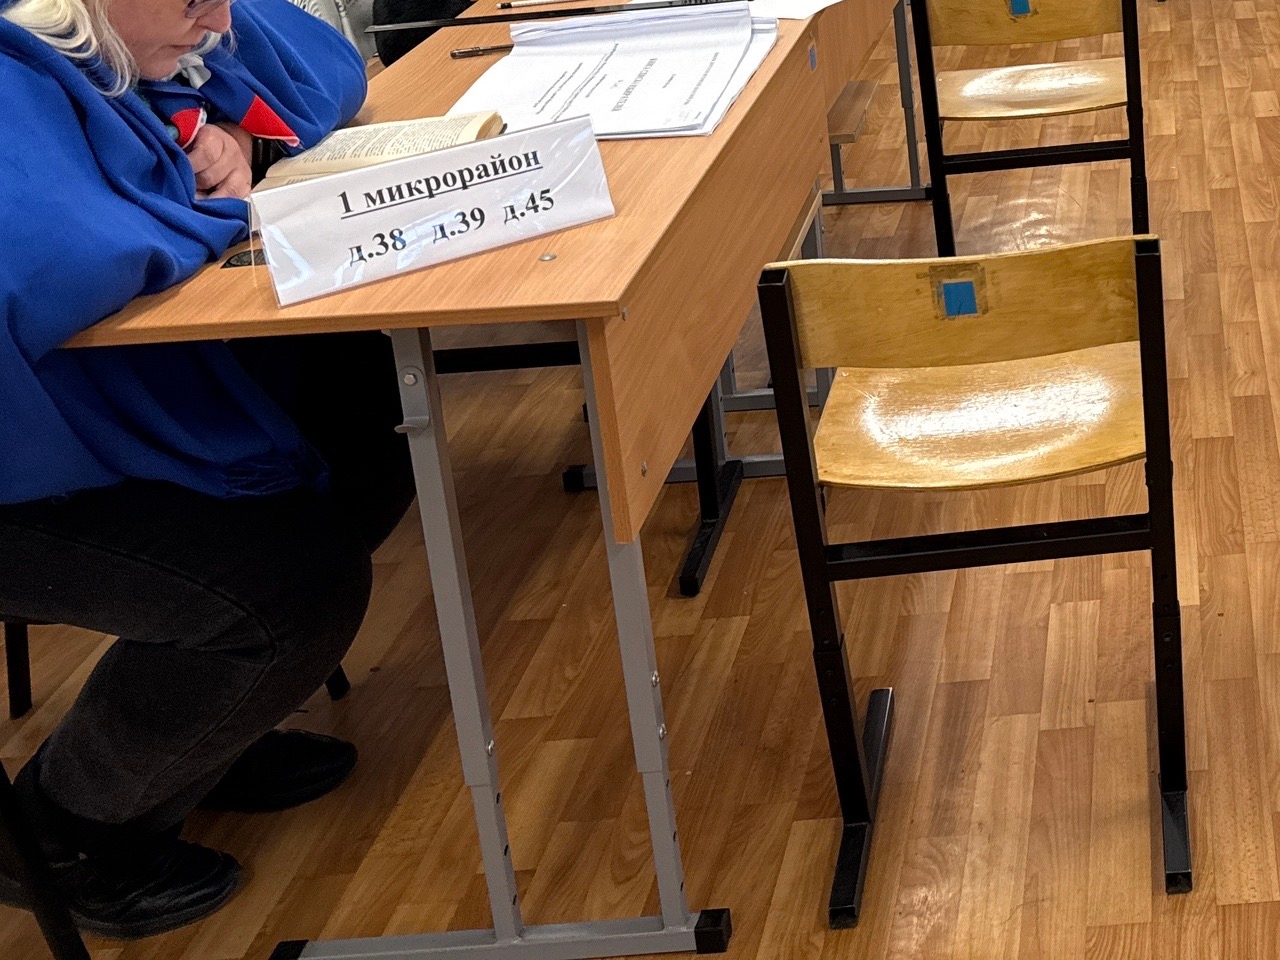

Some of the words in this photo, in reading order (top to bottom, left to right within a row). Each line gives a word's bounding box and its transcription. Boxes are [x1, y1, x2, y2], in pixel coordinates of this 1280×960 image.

[337, 191, 353, 215] 1
[362, 150, 541, 199] микрорайон
[348, 228, 407, 267] д.38
[432, 207, 486, 244] д.39
[503, 188, 555, 225] д.45
